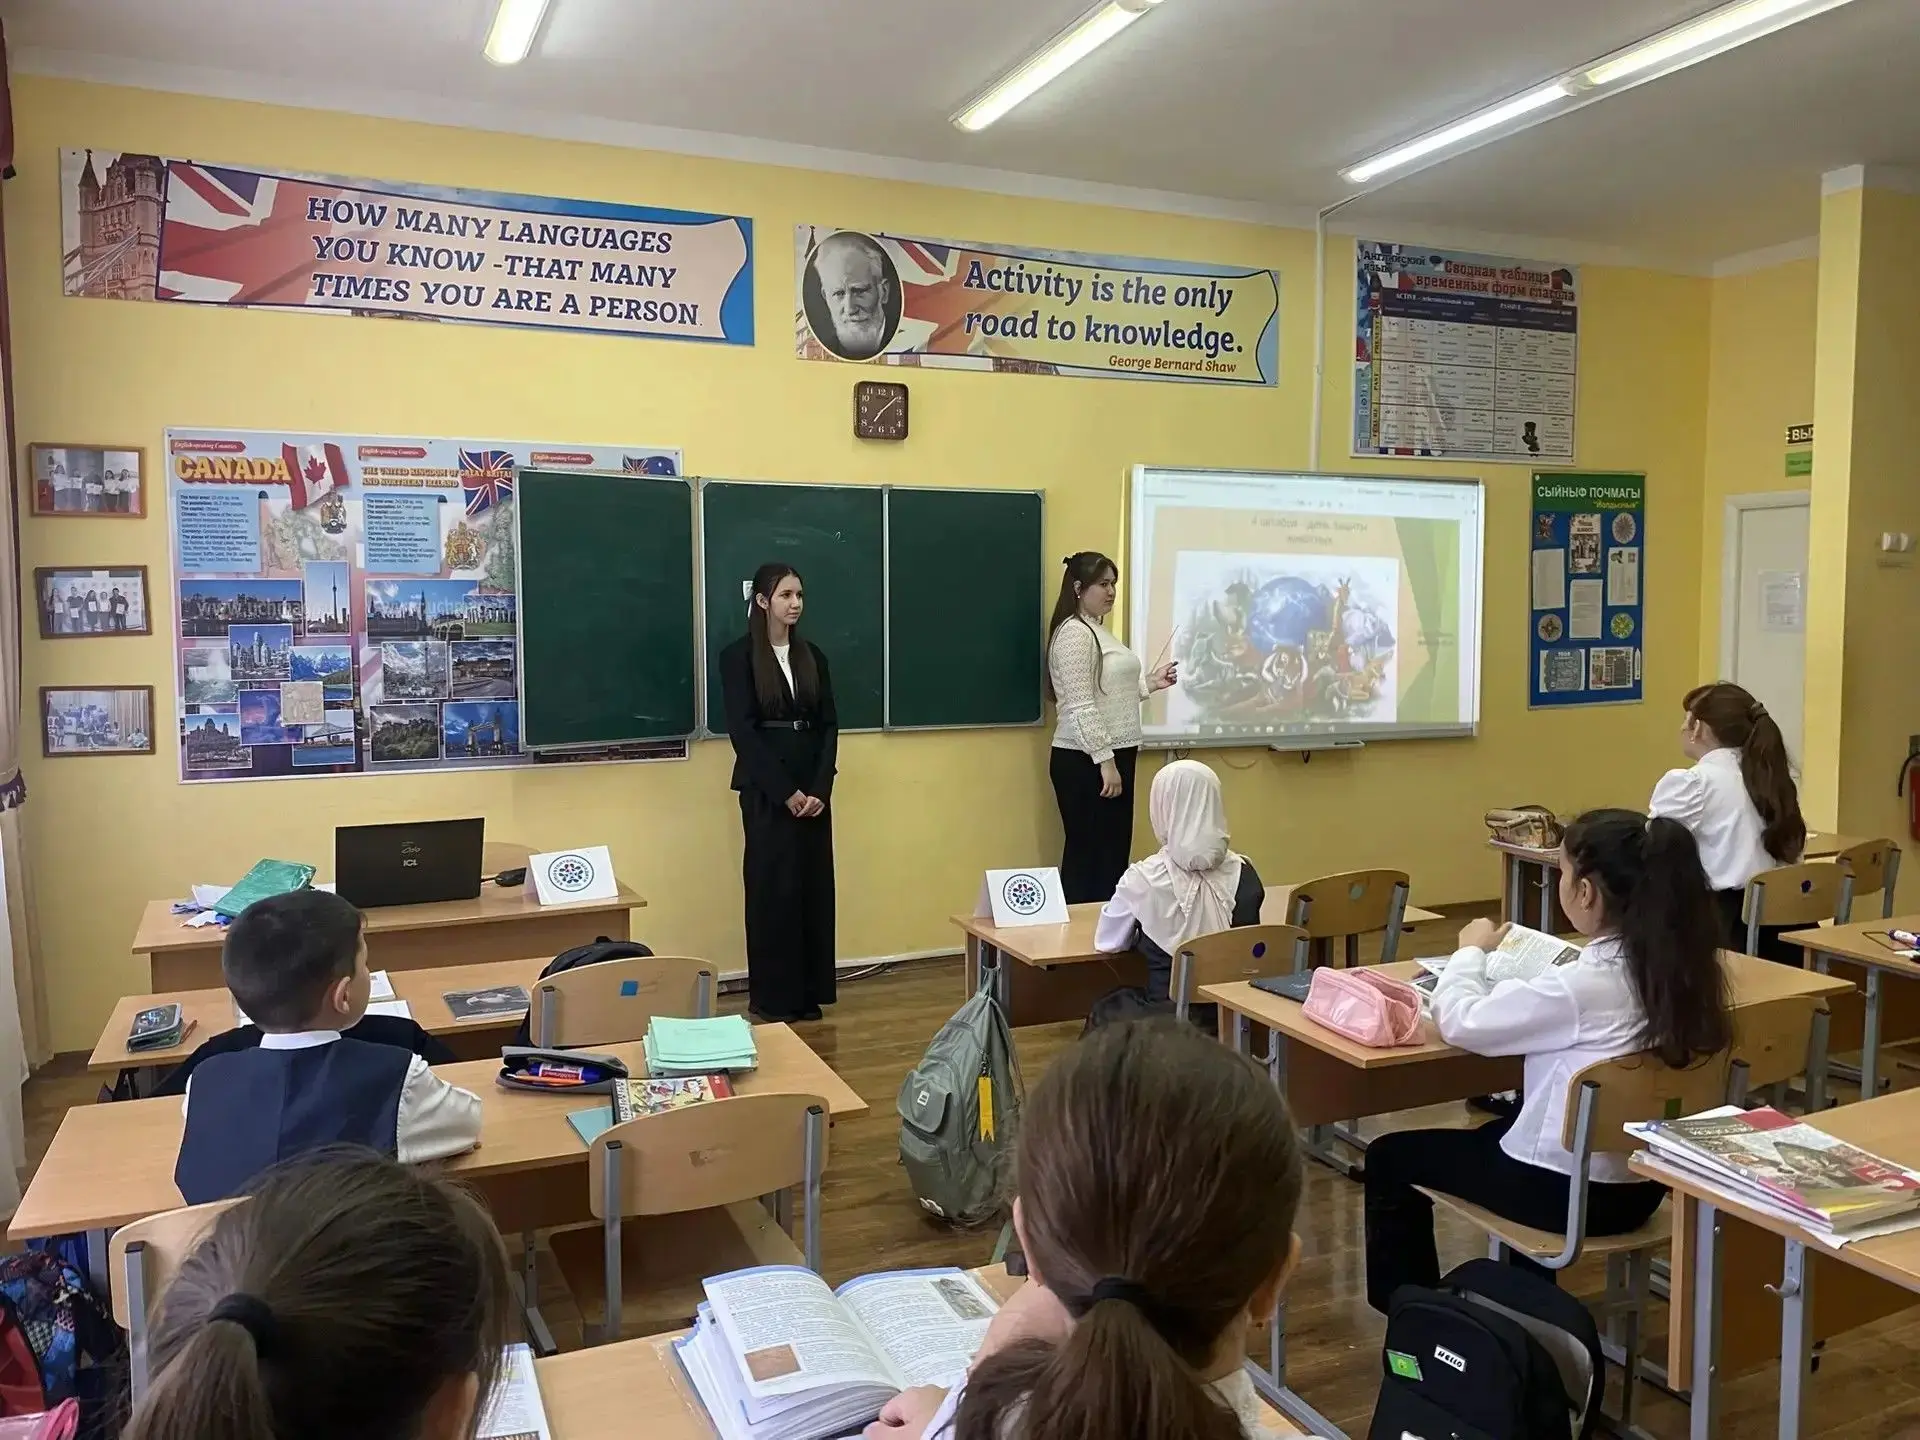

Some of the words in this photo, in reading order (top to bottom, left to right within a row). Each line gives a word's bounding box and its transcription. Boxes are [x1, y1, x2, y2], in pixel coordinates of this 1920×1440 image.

[307, 197, 388, 227] HOW
[394, 207, 491, 239] MANY
[498, 221, 672, 255] LANGUAGES
[312, 235, 381, 264] YOU
[386, 243, 484, 273] KNOW
[494, 255, 583, 281] -THAT
[591, 262, 678, 289] MANY
[1444, 260, 1497, 278] Сводная
[1501, 267, 1550, 284] таблица
[963, 260, 1084, 303] Activity
[1092, 273, 1115, 301] is
[1122, 276, 1167, 306] the
[1173, 280, 1233, 318] only
[1415, 274, 1489, 293] временных
[1492, 280, 1526, 298] форм
[312, 273, 410, 303] TIMES
[420, 281, 485, 309] YOU
[493, 288, 553, 312] ARE
[561, 293, 581, 315] A
[588, 296, 704, 328] PERSON.
[964, 310, 1039, 339] road
[1047, 315, 1077, 340] to
[1084, 314, 1244, 359] knowledge.
[1108, 354, 1152, 374] George
[1154, 357, 1203, 372] Bernard
[1205, 359, 1237, 374] Shaw
[1792, 428, 1813, 441] ВЫ
[175, 455, 292, 484] CANADA
[362, 467, 379, 475] THE
[380, 467, 409, 476] UNITED
[409, 468, 448, 477] KINGDOM
[449, 469, 459, 477] OF
[460, 469, 484, 477] GREAT
[486, 470, 513, 478] BRITAI
[362, 478, 379, 486] AND
[380, 479, 423, 487] NORTHERN
[426, 480, 459, 488] IRELAND
[1537, 485, 1587, 498] СЫЙНЫФ
[1590, 487, 1640, 499] ПОЧМАГЫ
[403, 858, 418, 867] ICL
